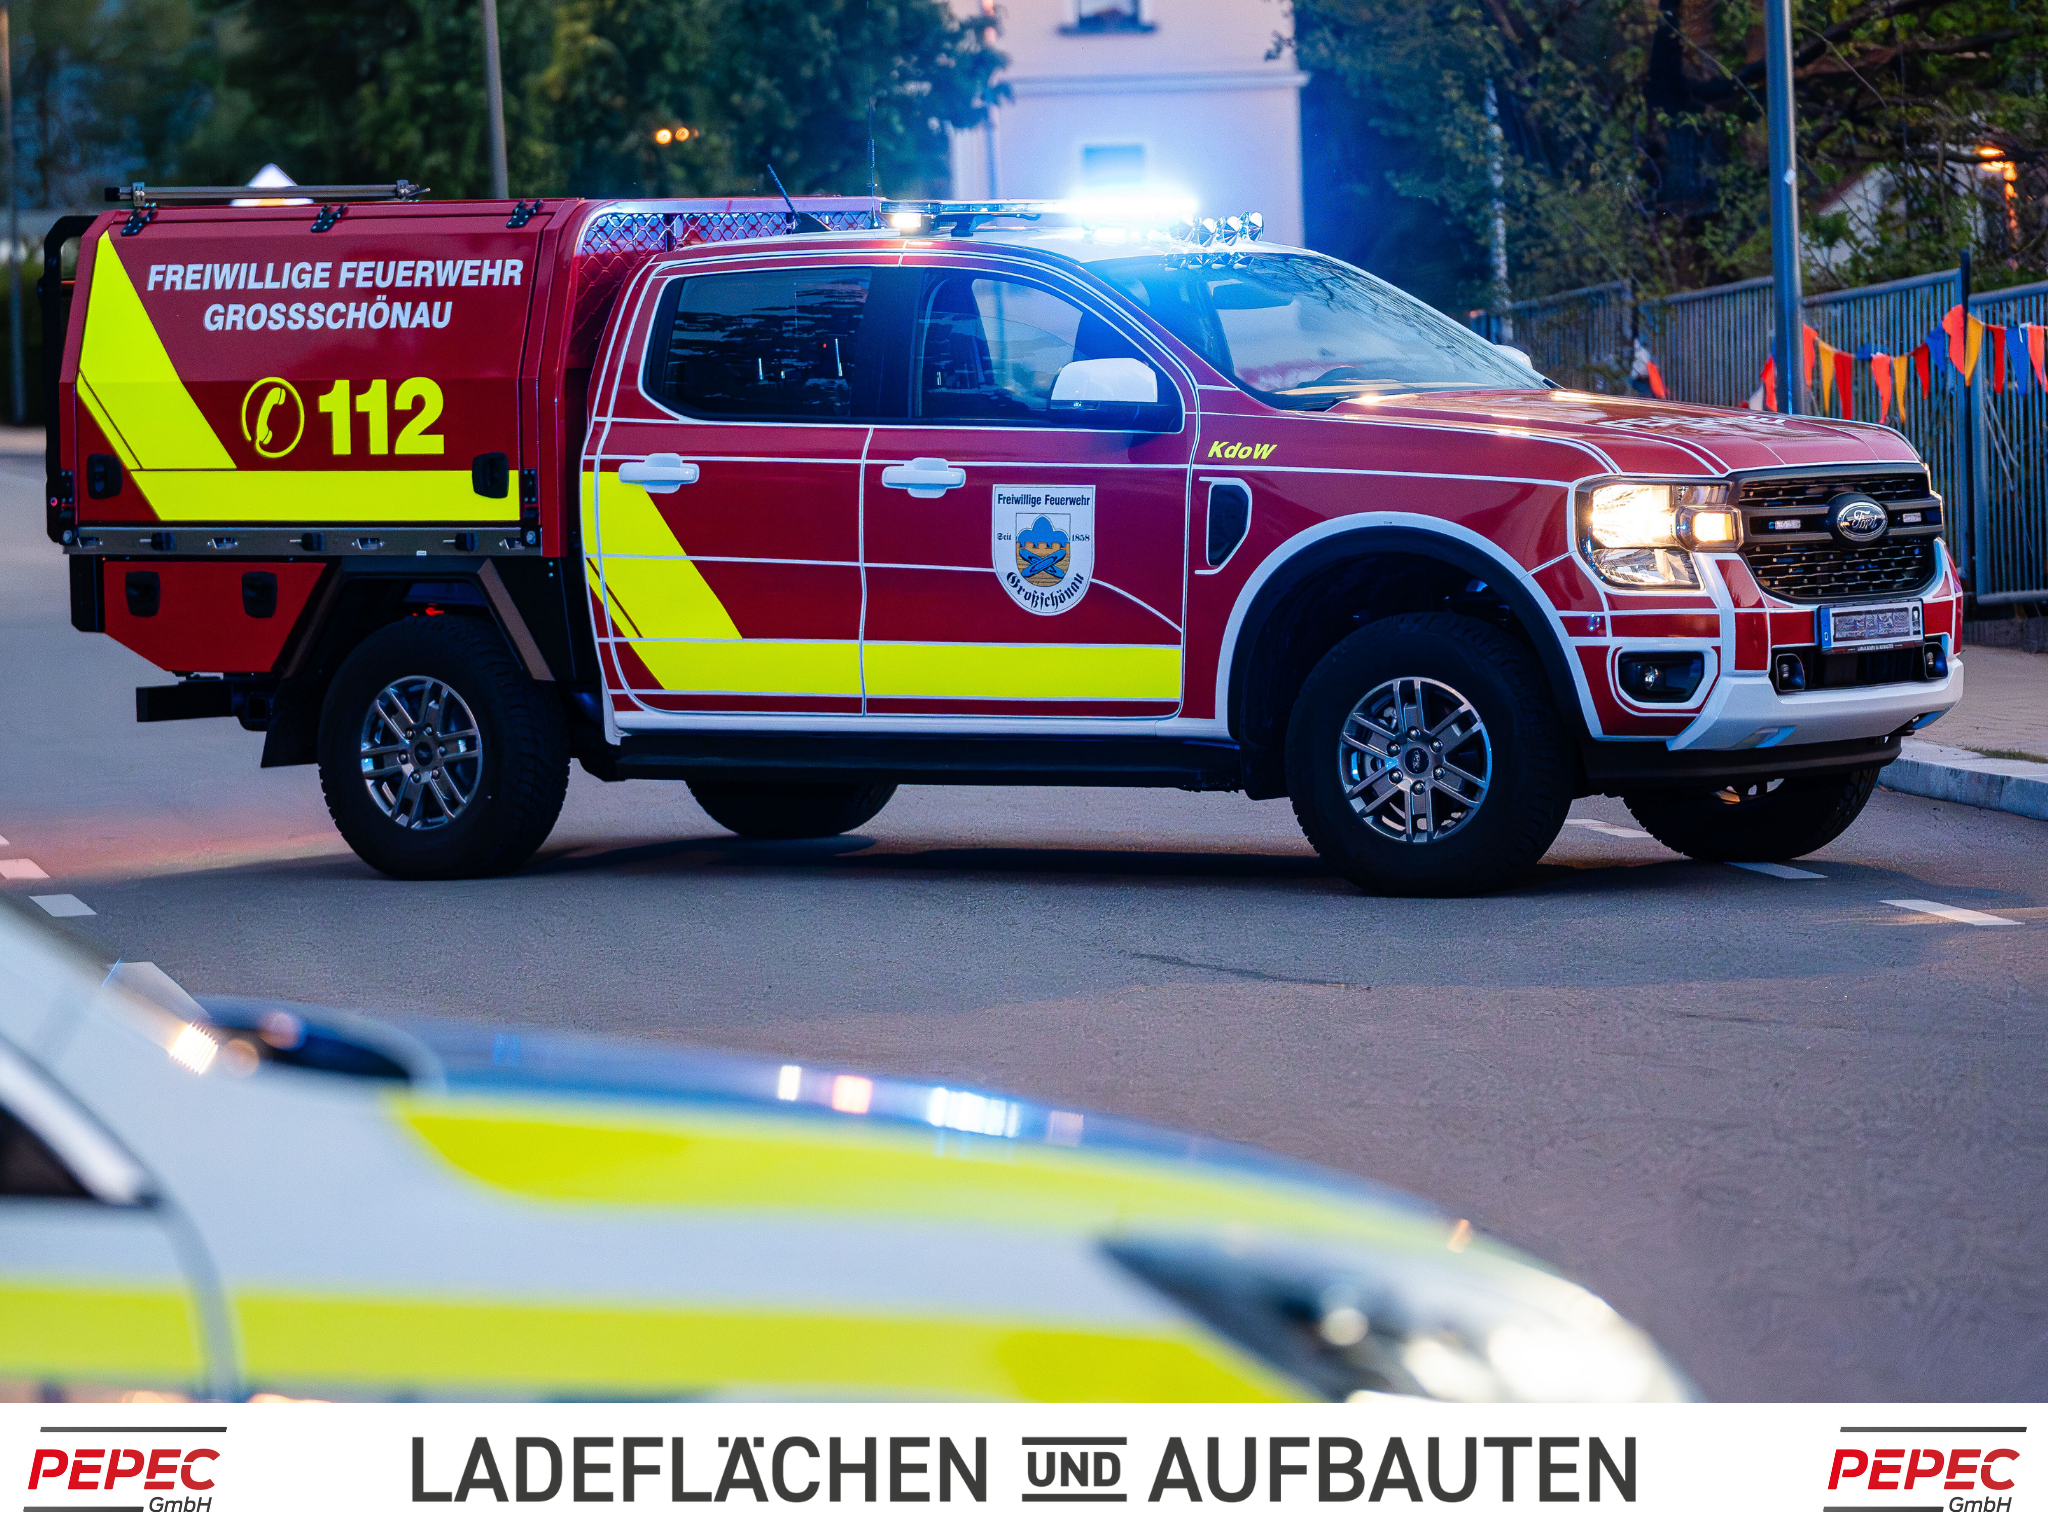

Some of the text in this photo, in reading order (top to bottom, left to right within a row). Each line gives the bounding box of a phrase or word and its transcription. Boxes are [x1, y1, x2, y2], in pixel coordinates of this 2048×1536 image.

[147, 259, 524, 291] FREIWILLIGE FEUERWEHR
[203, 294, 453, 331] GROSSSCHÖNAU
[318, 376, 445, 456] 112
[1207, 440, 1278, 460] KdoW
[997, 493, 1091, 508] Freiwillige Feuerwehr
[996, 532, 1012, 541] Seit
[1006, 571, 1085, 610] Großschönau
